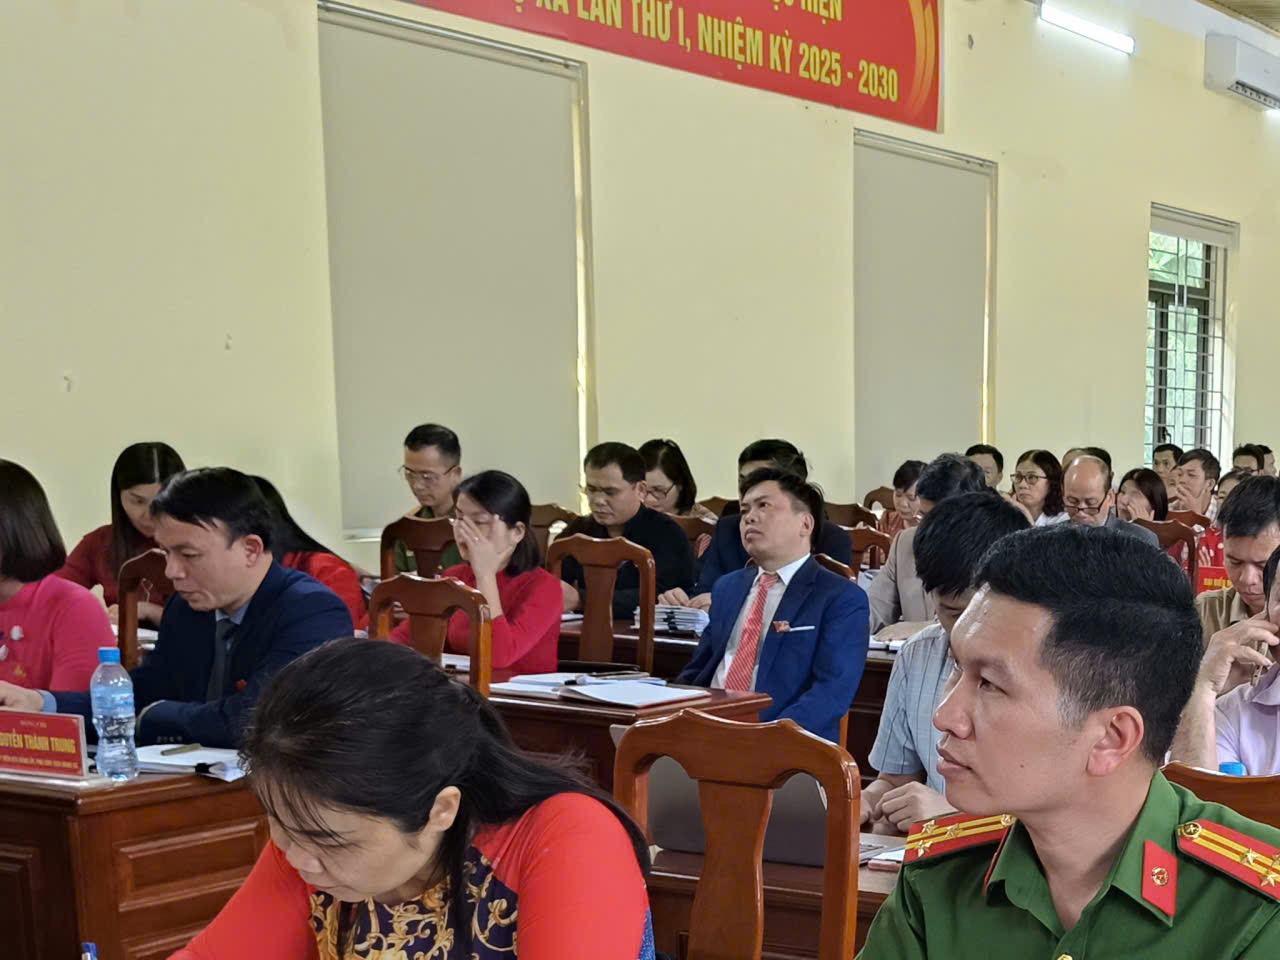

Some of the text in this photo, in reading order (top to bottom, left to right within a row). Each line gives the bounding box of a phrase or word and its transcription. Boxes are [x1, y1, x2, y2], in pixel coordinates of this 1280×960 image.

[697, 13, 763, 70] NHIỆM
[769, 29, 793, 74] KỲ
[799, 42, 842, 87] 2025
[858, 59, 899, 102] 2030
